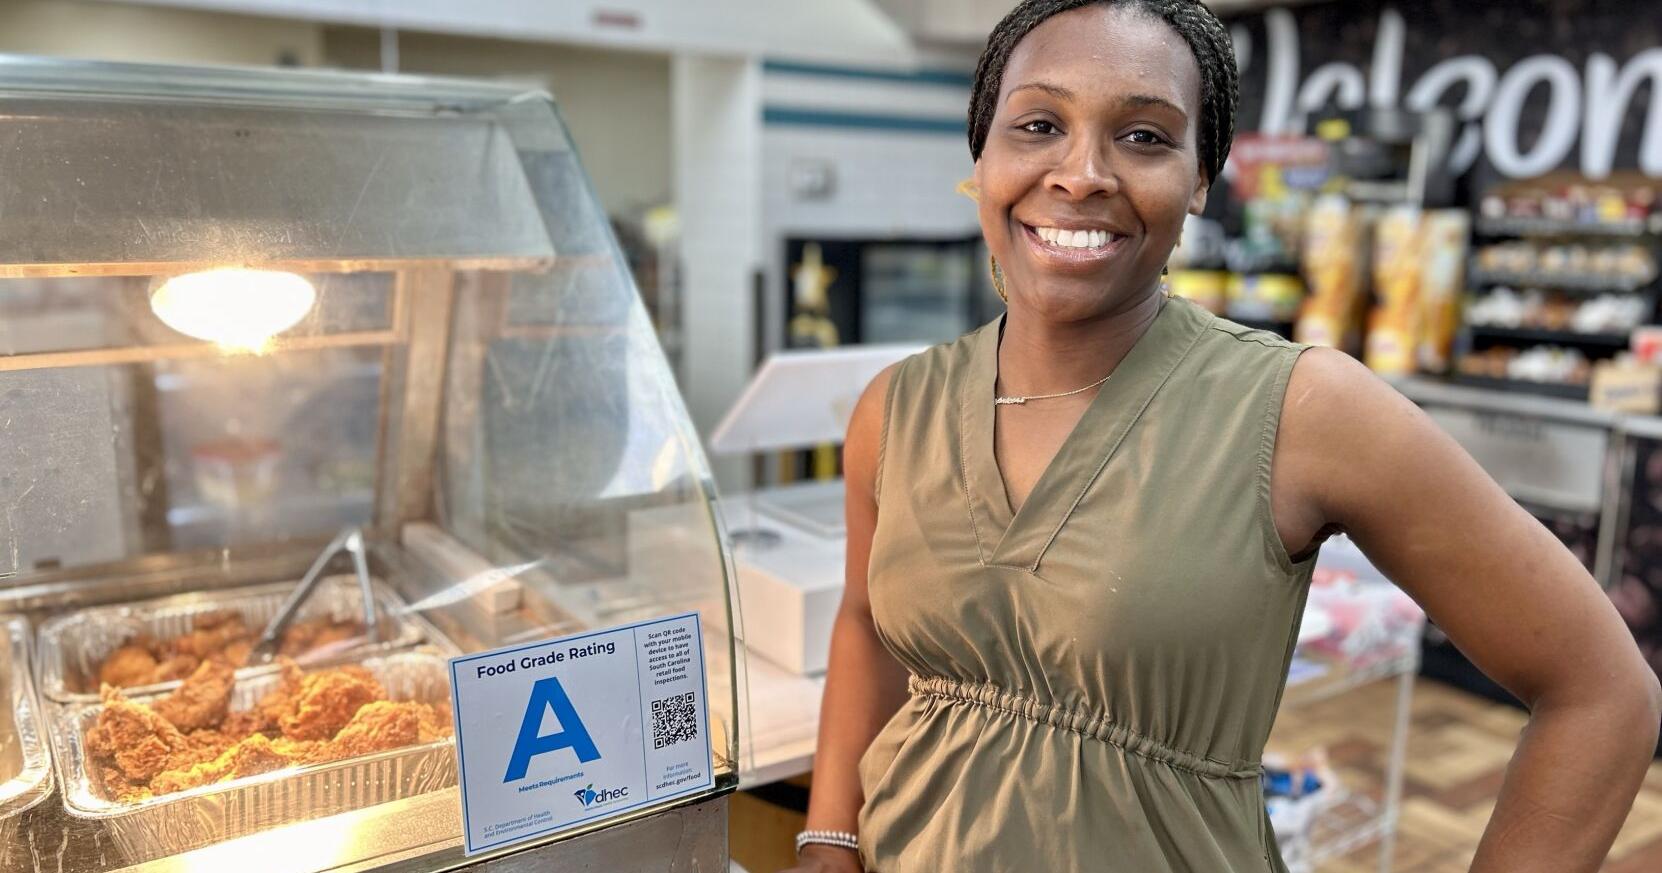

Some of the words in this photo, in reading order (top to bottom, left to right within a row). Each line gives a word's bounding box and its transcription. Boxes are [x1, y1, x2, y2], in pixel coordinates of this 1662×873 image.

[658, 638, 671, 647] your
[672, 634, 691, 642] mobile
[648, 647, 666, 655] device
[649, 655, 667, 663] access
[477, 659, 516, 679] Food
[520, 651, 565, 670] Grade
[569, 642, 616, 660] Rating
[649, 662, 666, 671] South
[667, 658, 690, 667] Carolina
[655, 674, 688, 685] inspections.
[656, 669, 671, 677] retail
[502, 676, 602, 783] A
[518, 782, 539, 793] Meets
[539, 771, 584, 787] Requirements
[656, 772, 701, 790] scdhec.gov/food
[595, 786, 629, 803] dhec
[484, 831, 495, 839] and
[496, 821, 534, 836] Environmental
[534, 816, 553, 825] Control
[495, 816, 526, 830] Department
[527, 813, 534, 821] of
[534, 810, 551, 818] Health
